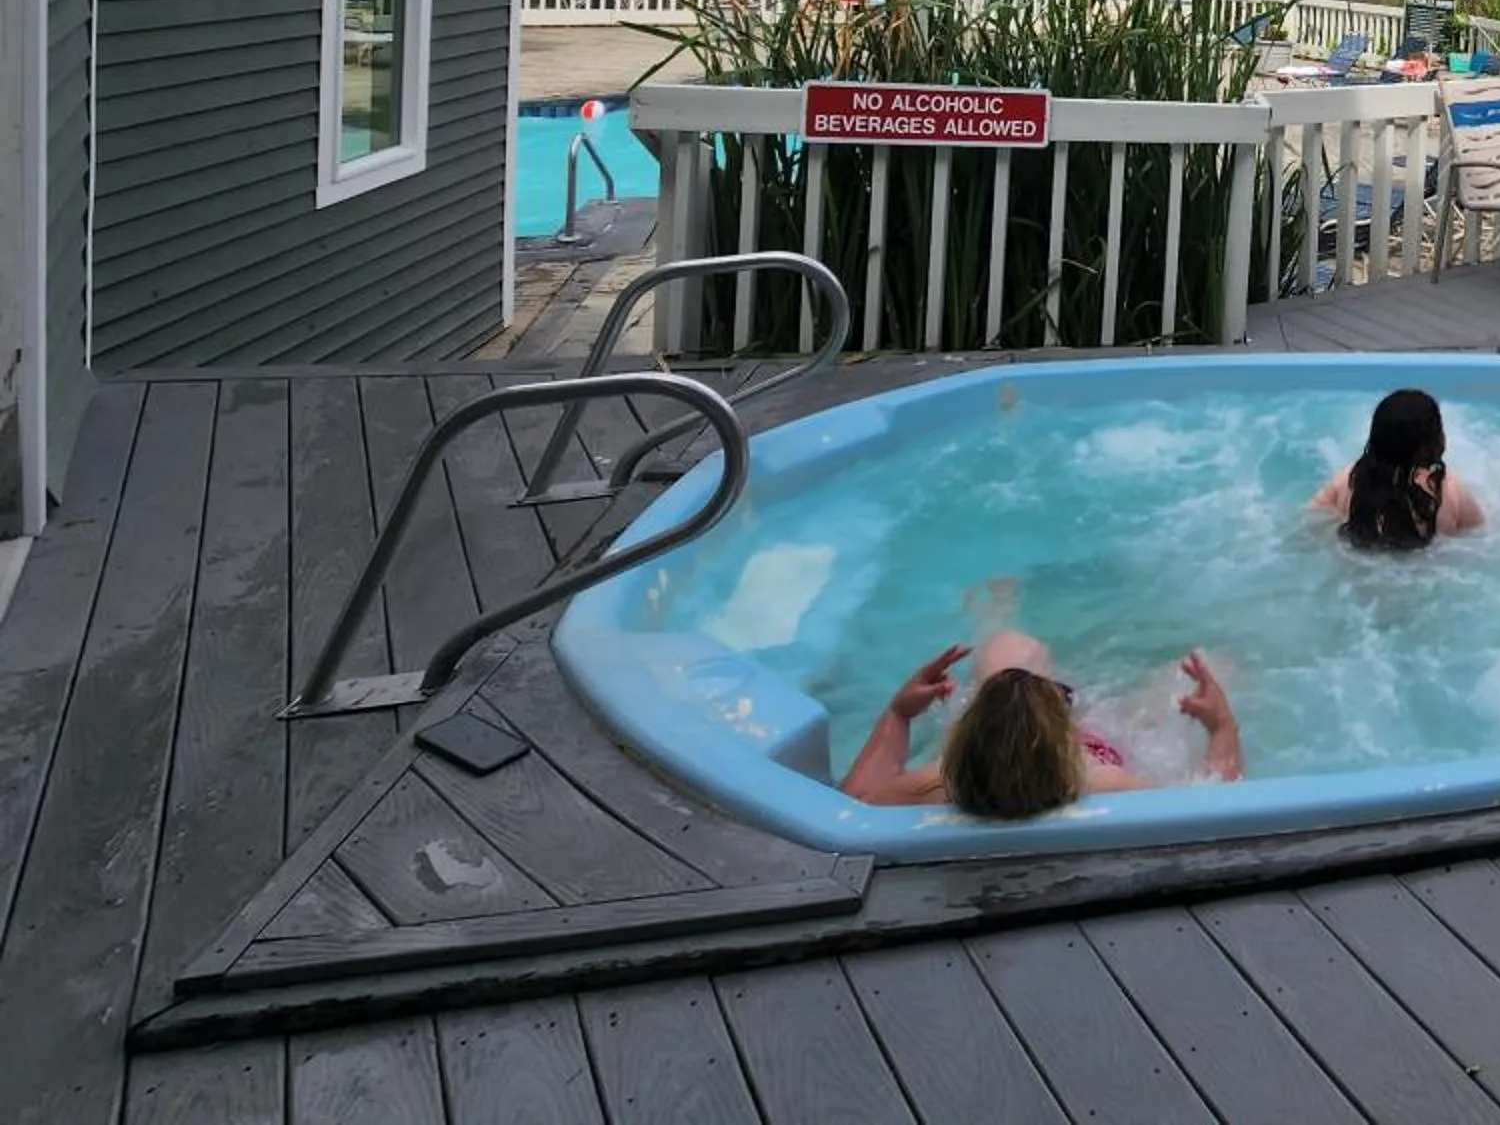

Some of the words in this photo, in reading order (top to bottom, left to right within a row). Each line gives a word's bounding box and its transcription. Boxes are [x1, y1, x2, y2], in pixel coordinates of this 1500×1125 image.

[853, 92, 883, 111] NO
[891, 94, 1004, 114] ALCOHOLIC
[814, 114, 936, 135] BEVERAGES
[943, 118, 1037, 137] ALLOWED
